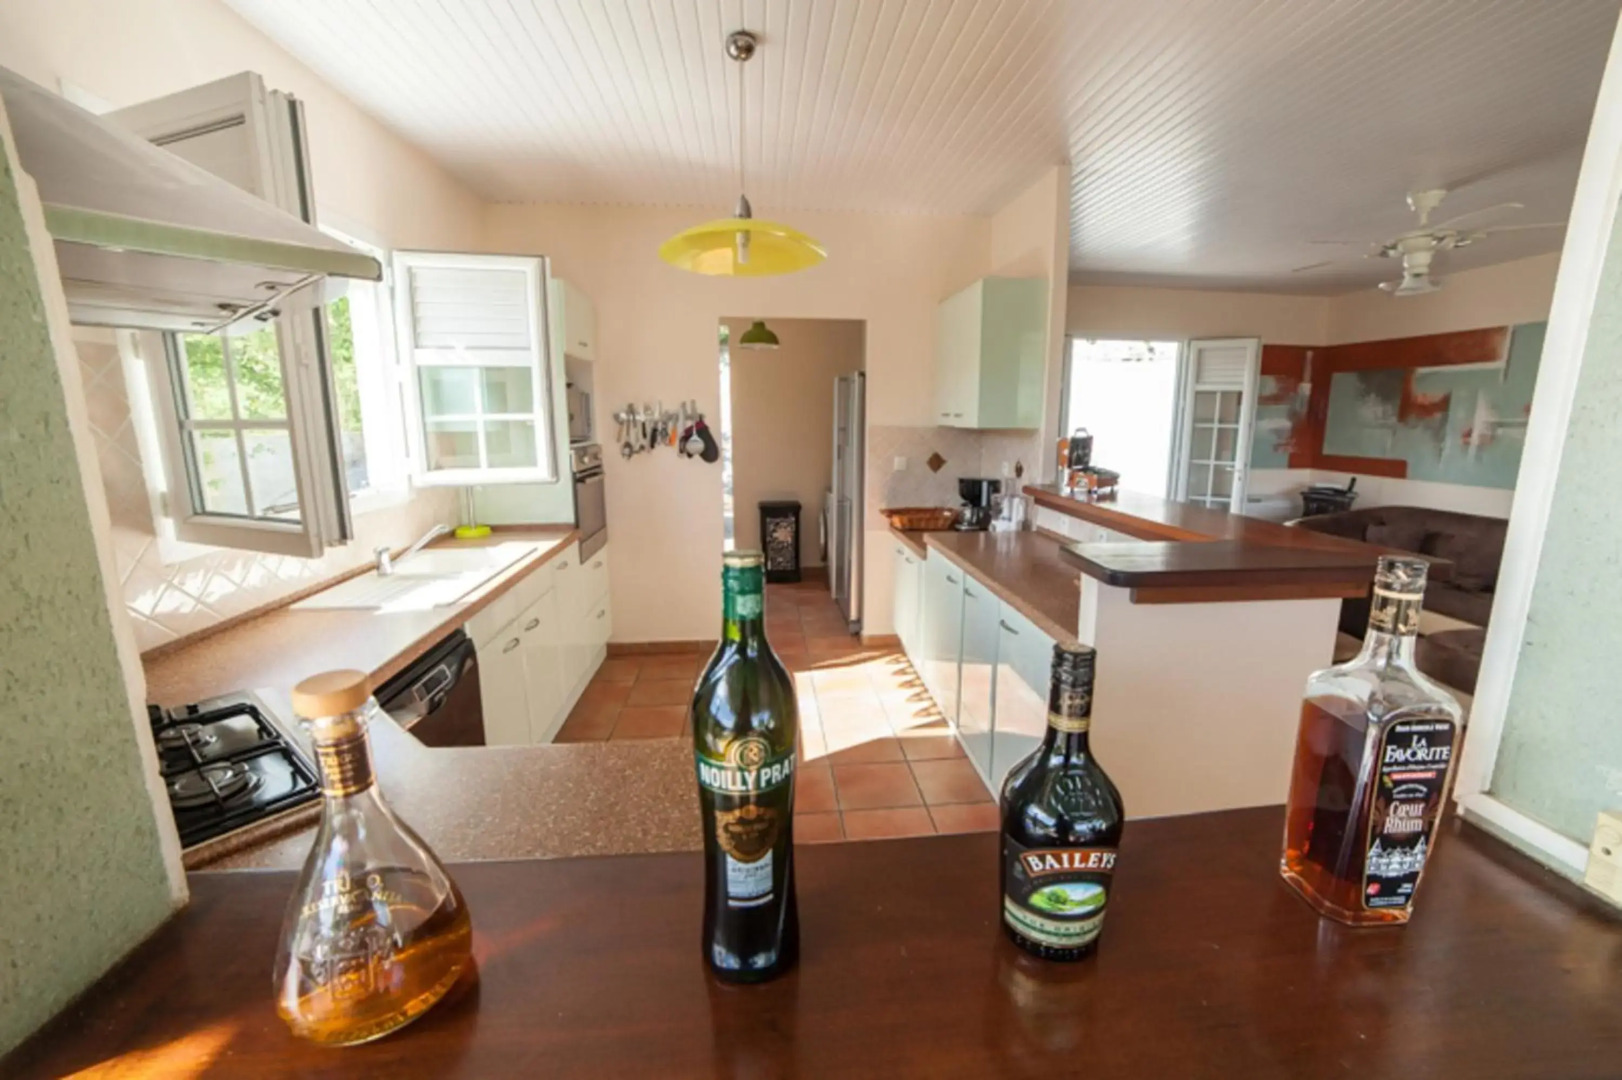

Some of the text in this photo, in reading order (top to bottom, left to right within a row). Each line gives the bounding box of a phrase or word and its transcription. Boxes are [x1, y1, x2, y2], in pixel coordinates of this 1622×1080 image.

[1411, 734, 1427, 748] LA
[1384, 745, 1451, 762] FAVORITE
[699, 761, 758, 791] NOILLY
[1026, 852, 1117, 872] BAILEYS
